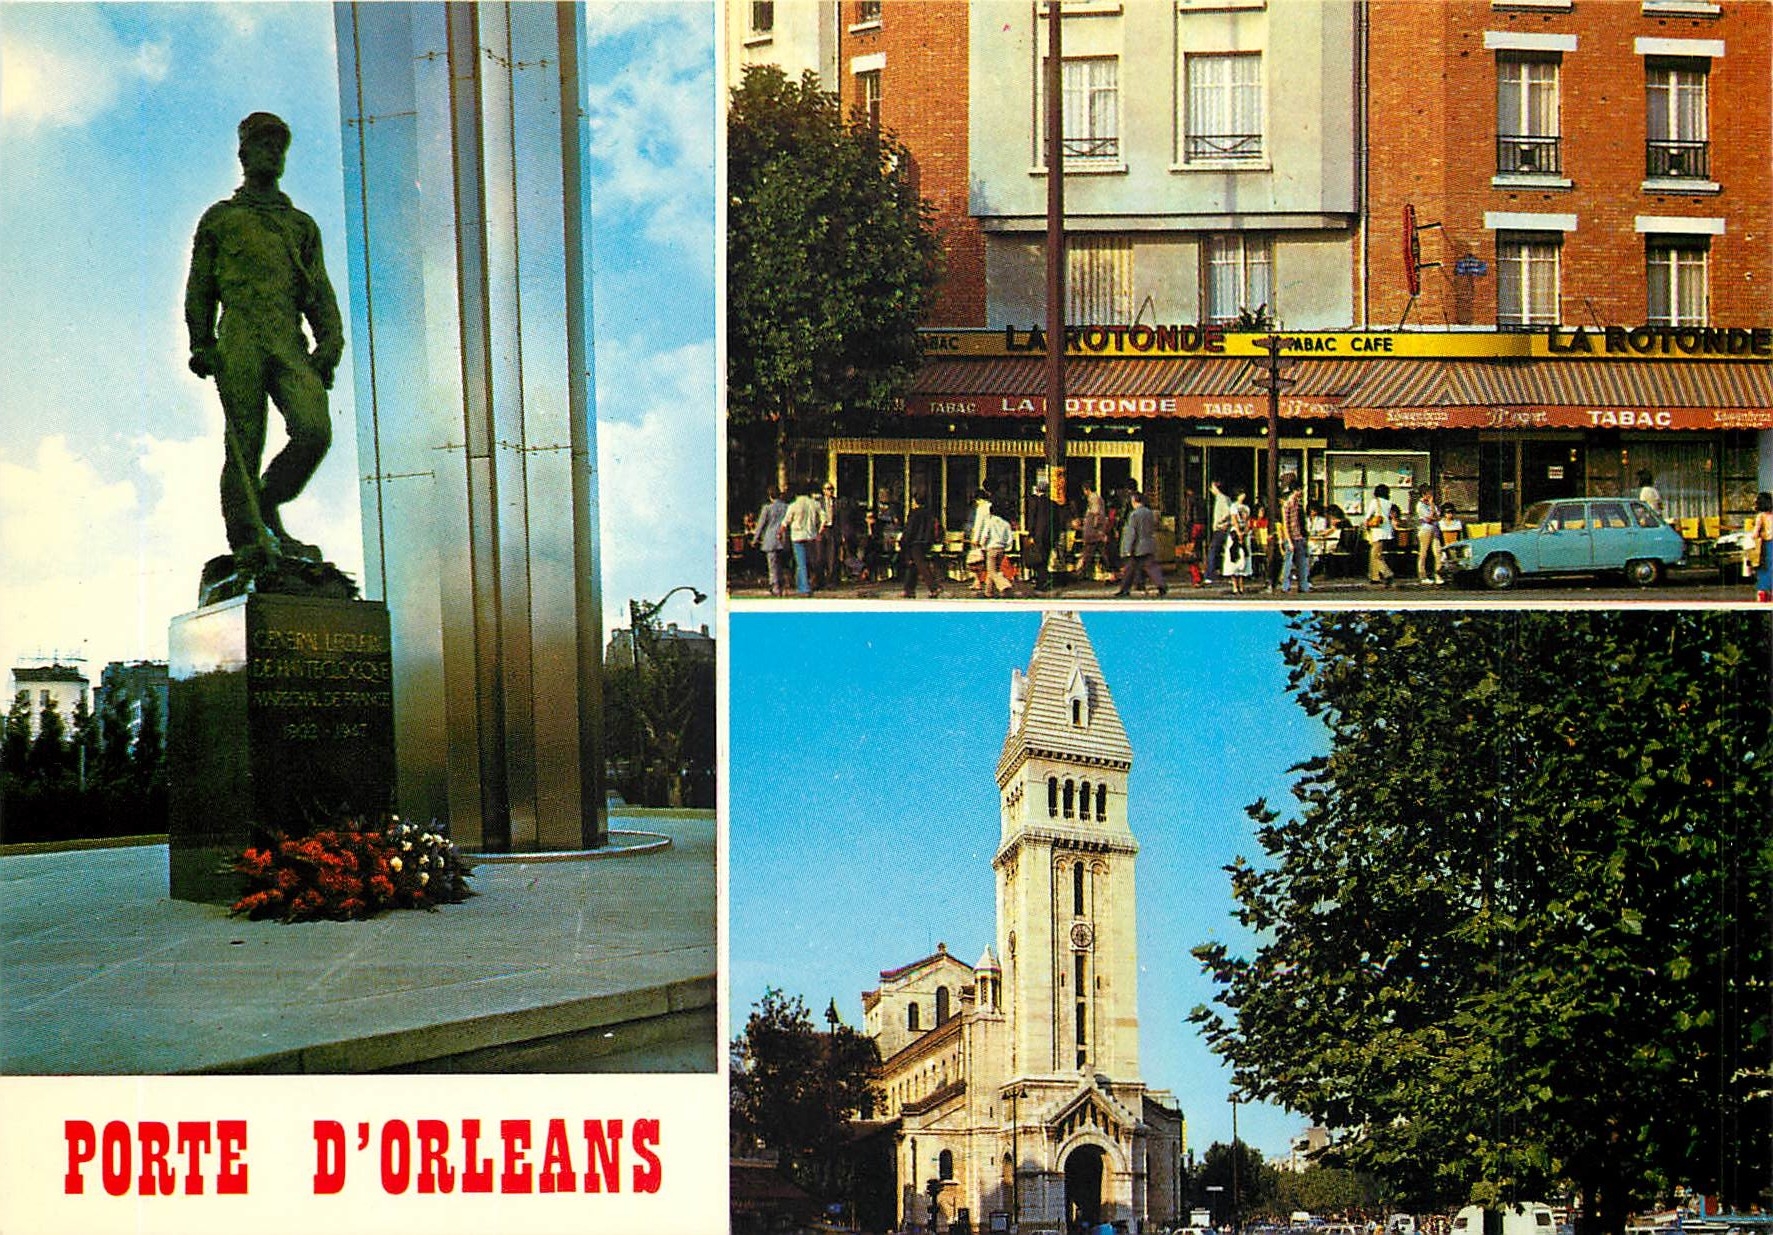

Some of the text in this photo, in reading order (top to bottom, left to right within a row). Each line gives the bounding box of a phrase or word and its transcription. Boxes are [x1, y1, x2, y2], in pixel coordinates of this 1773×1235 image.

[1006, 324, 1226, 352] LA ROTONDE
[1351, 337, 1393, 351] CAFE
[1549, 325, 1773, 354] LA ROTONDE
[929, 402, 976, 414] TABAC
[1002, 399, 1177, 413] LA OTONDE
[1203, 402, 1255, 415] TABAC
[1587, 411, 1671, 426] TABAC
